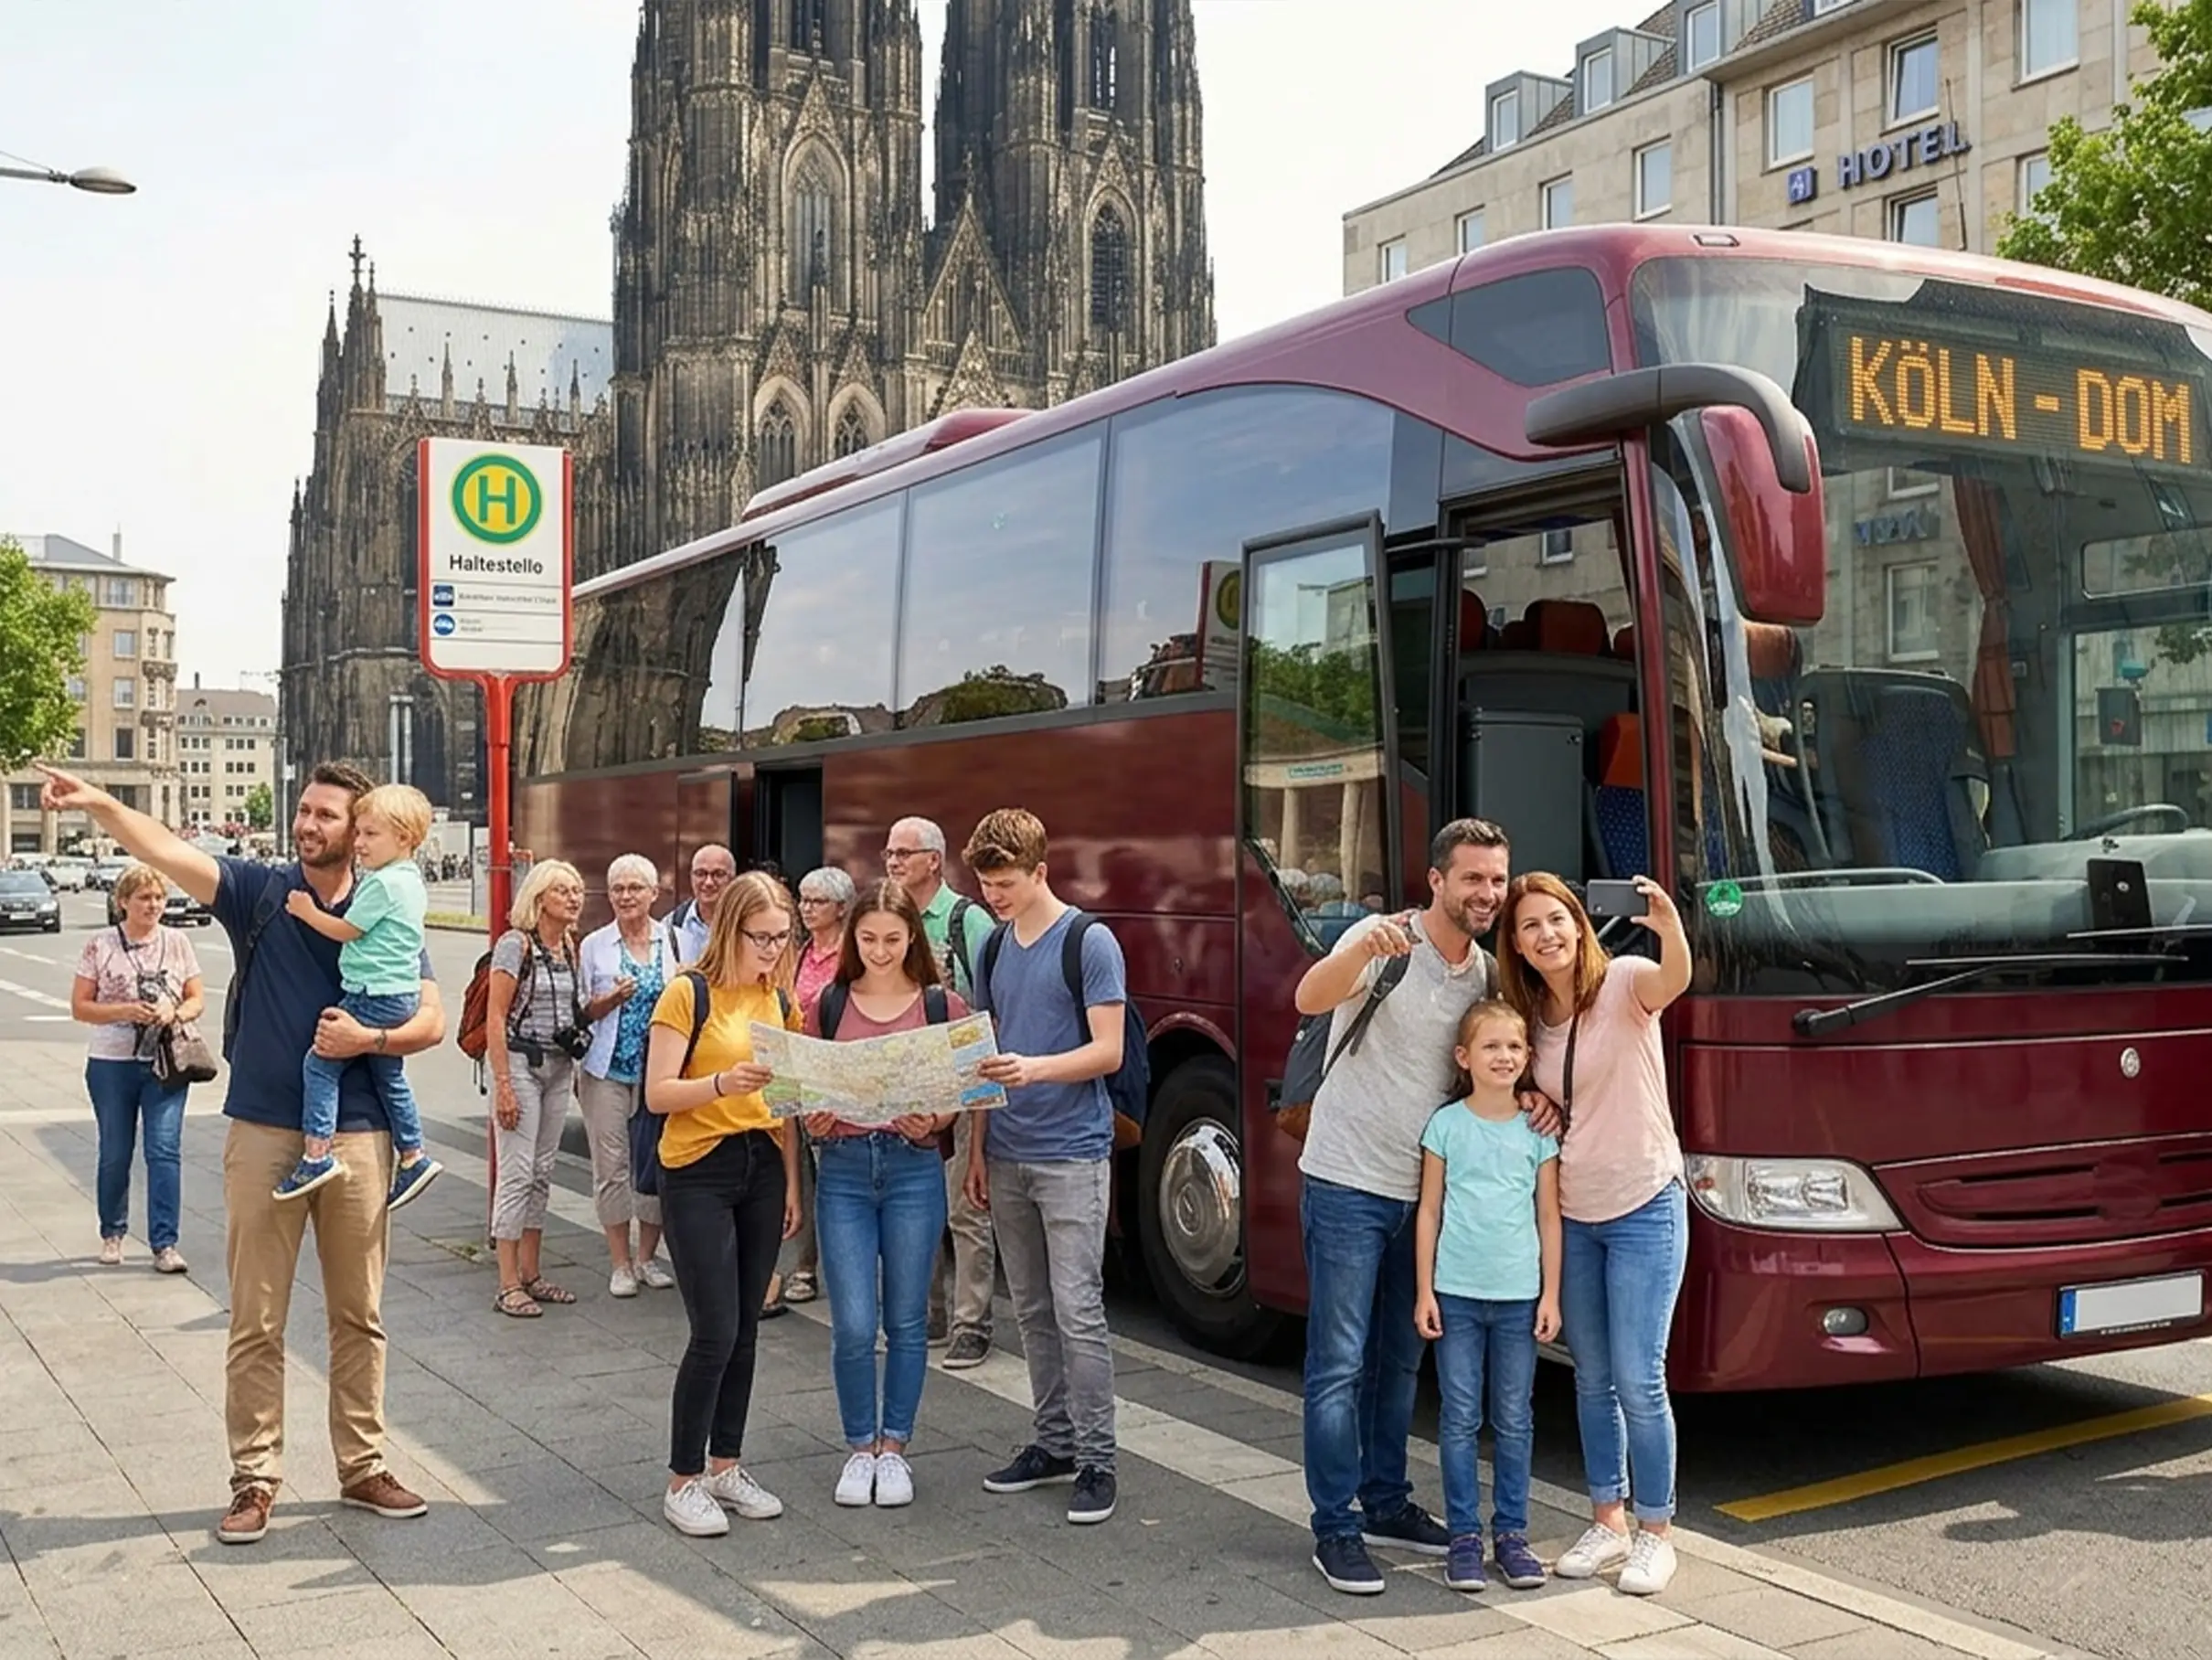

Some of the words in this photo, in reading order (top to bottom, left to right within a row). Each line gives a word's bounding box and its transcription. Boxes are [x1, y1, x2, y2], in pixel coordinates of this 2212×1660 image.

[1837, 121, 1972, 189] HOTEL
[1850, 335, 2017, 441] KÖLN
[2076, 367, 2193, 464] DOM
[478, 474, 516, 525] H
